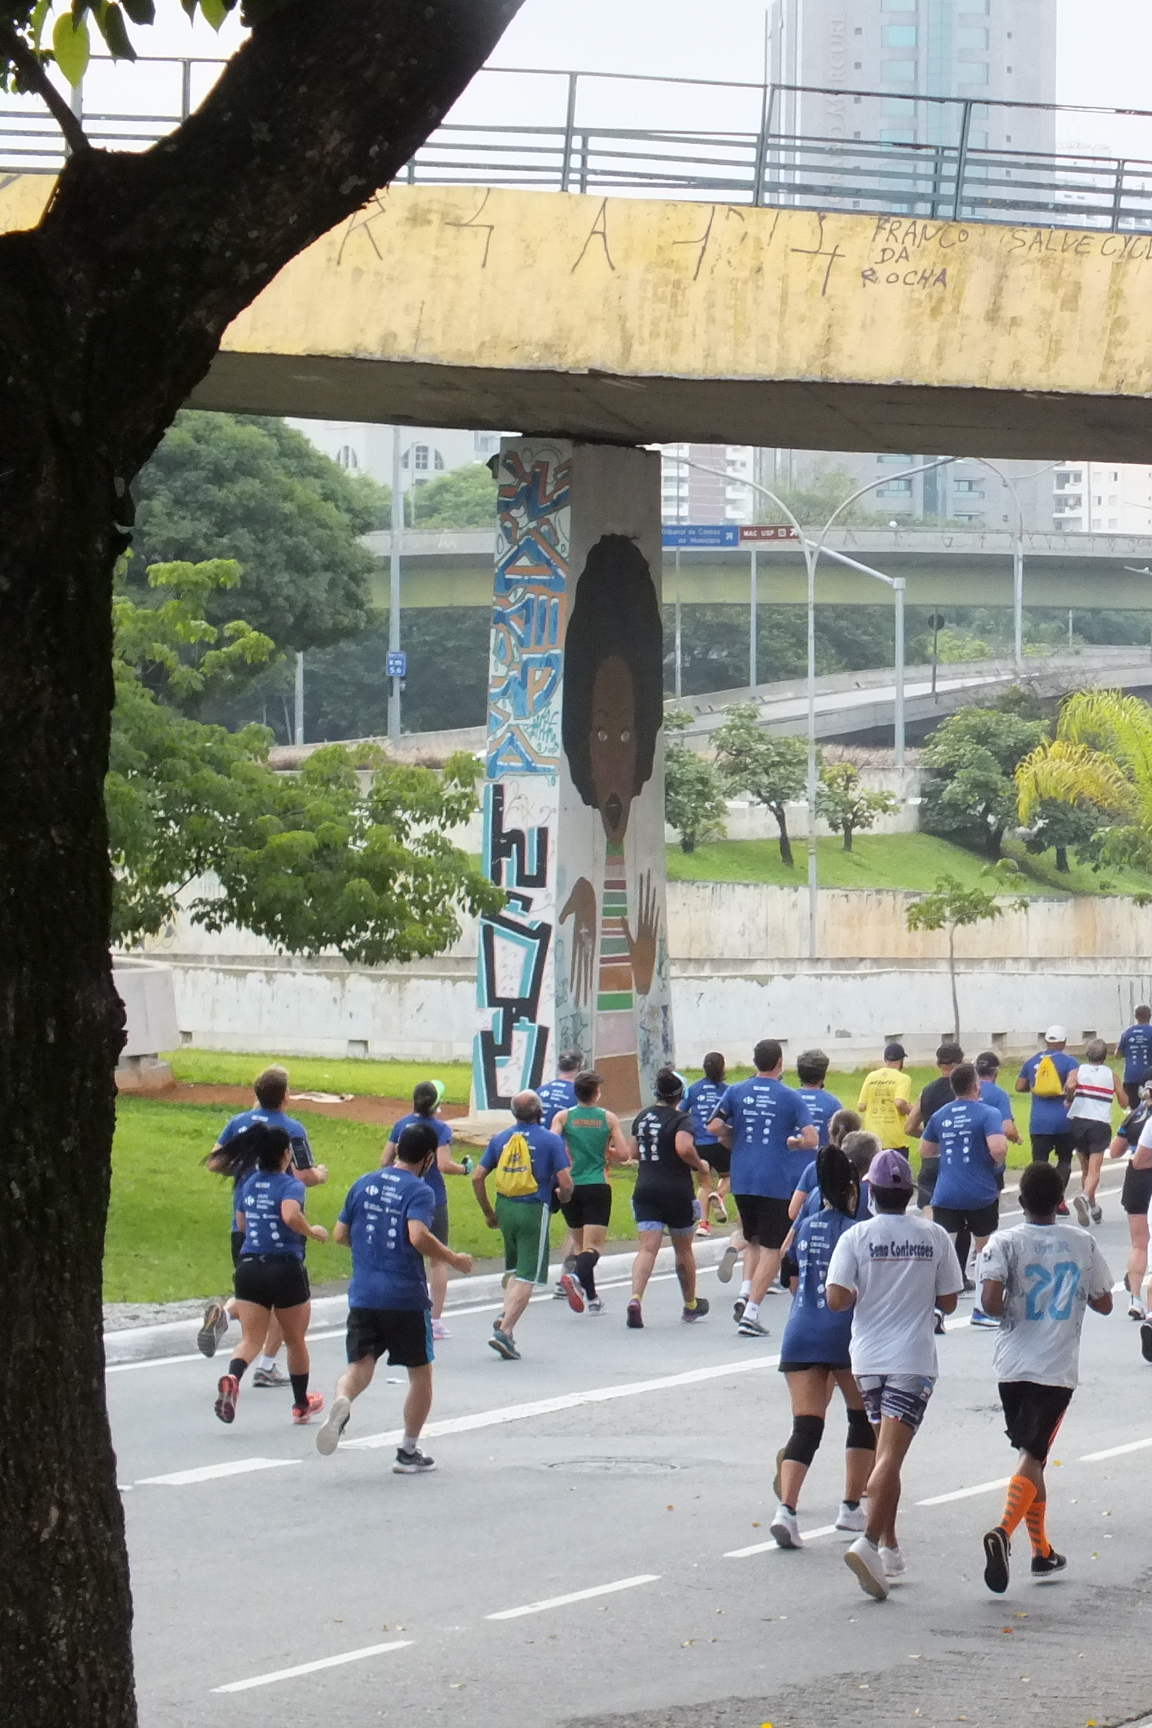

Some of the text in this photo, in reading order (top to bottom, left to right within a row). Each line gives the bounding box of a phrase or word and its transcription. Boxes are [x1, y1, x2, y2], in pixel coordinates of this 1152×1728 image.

[826, 15, 846, 122] MRCURE
[872, 217, 969, 249] FRANCO
[1008, 229, 1093, 256] SALVE
[875, 247, 910, 264] DA
[861, 267, 947, 288] ROCHA
[1025, 1261, 1082, 1321] 20
